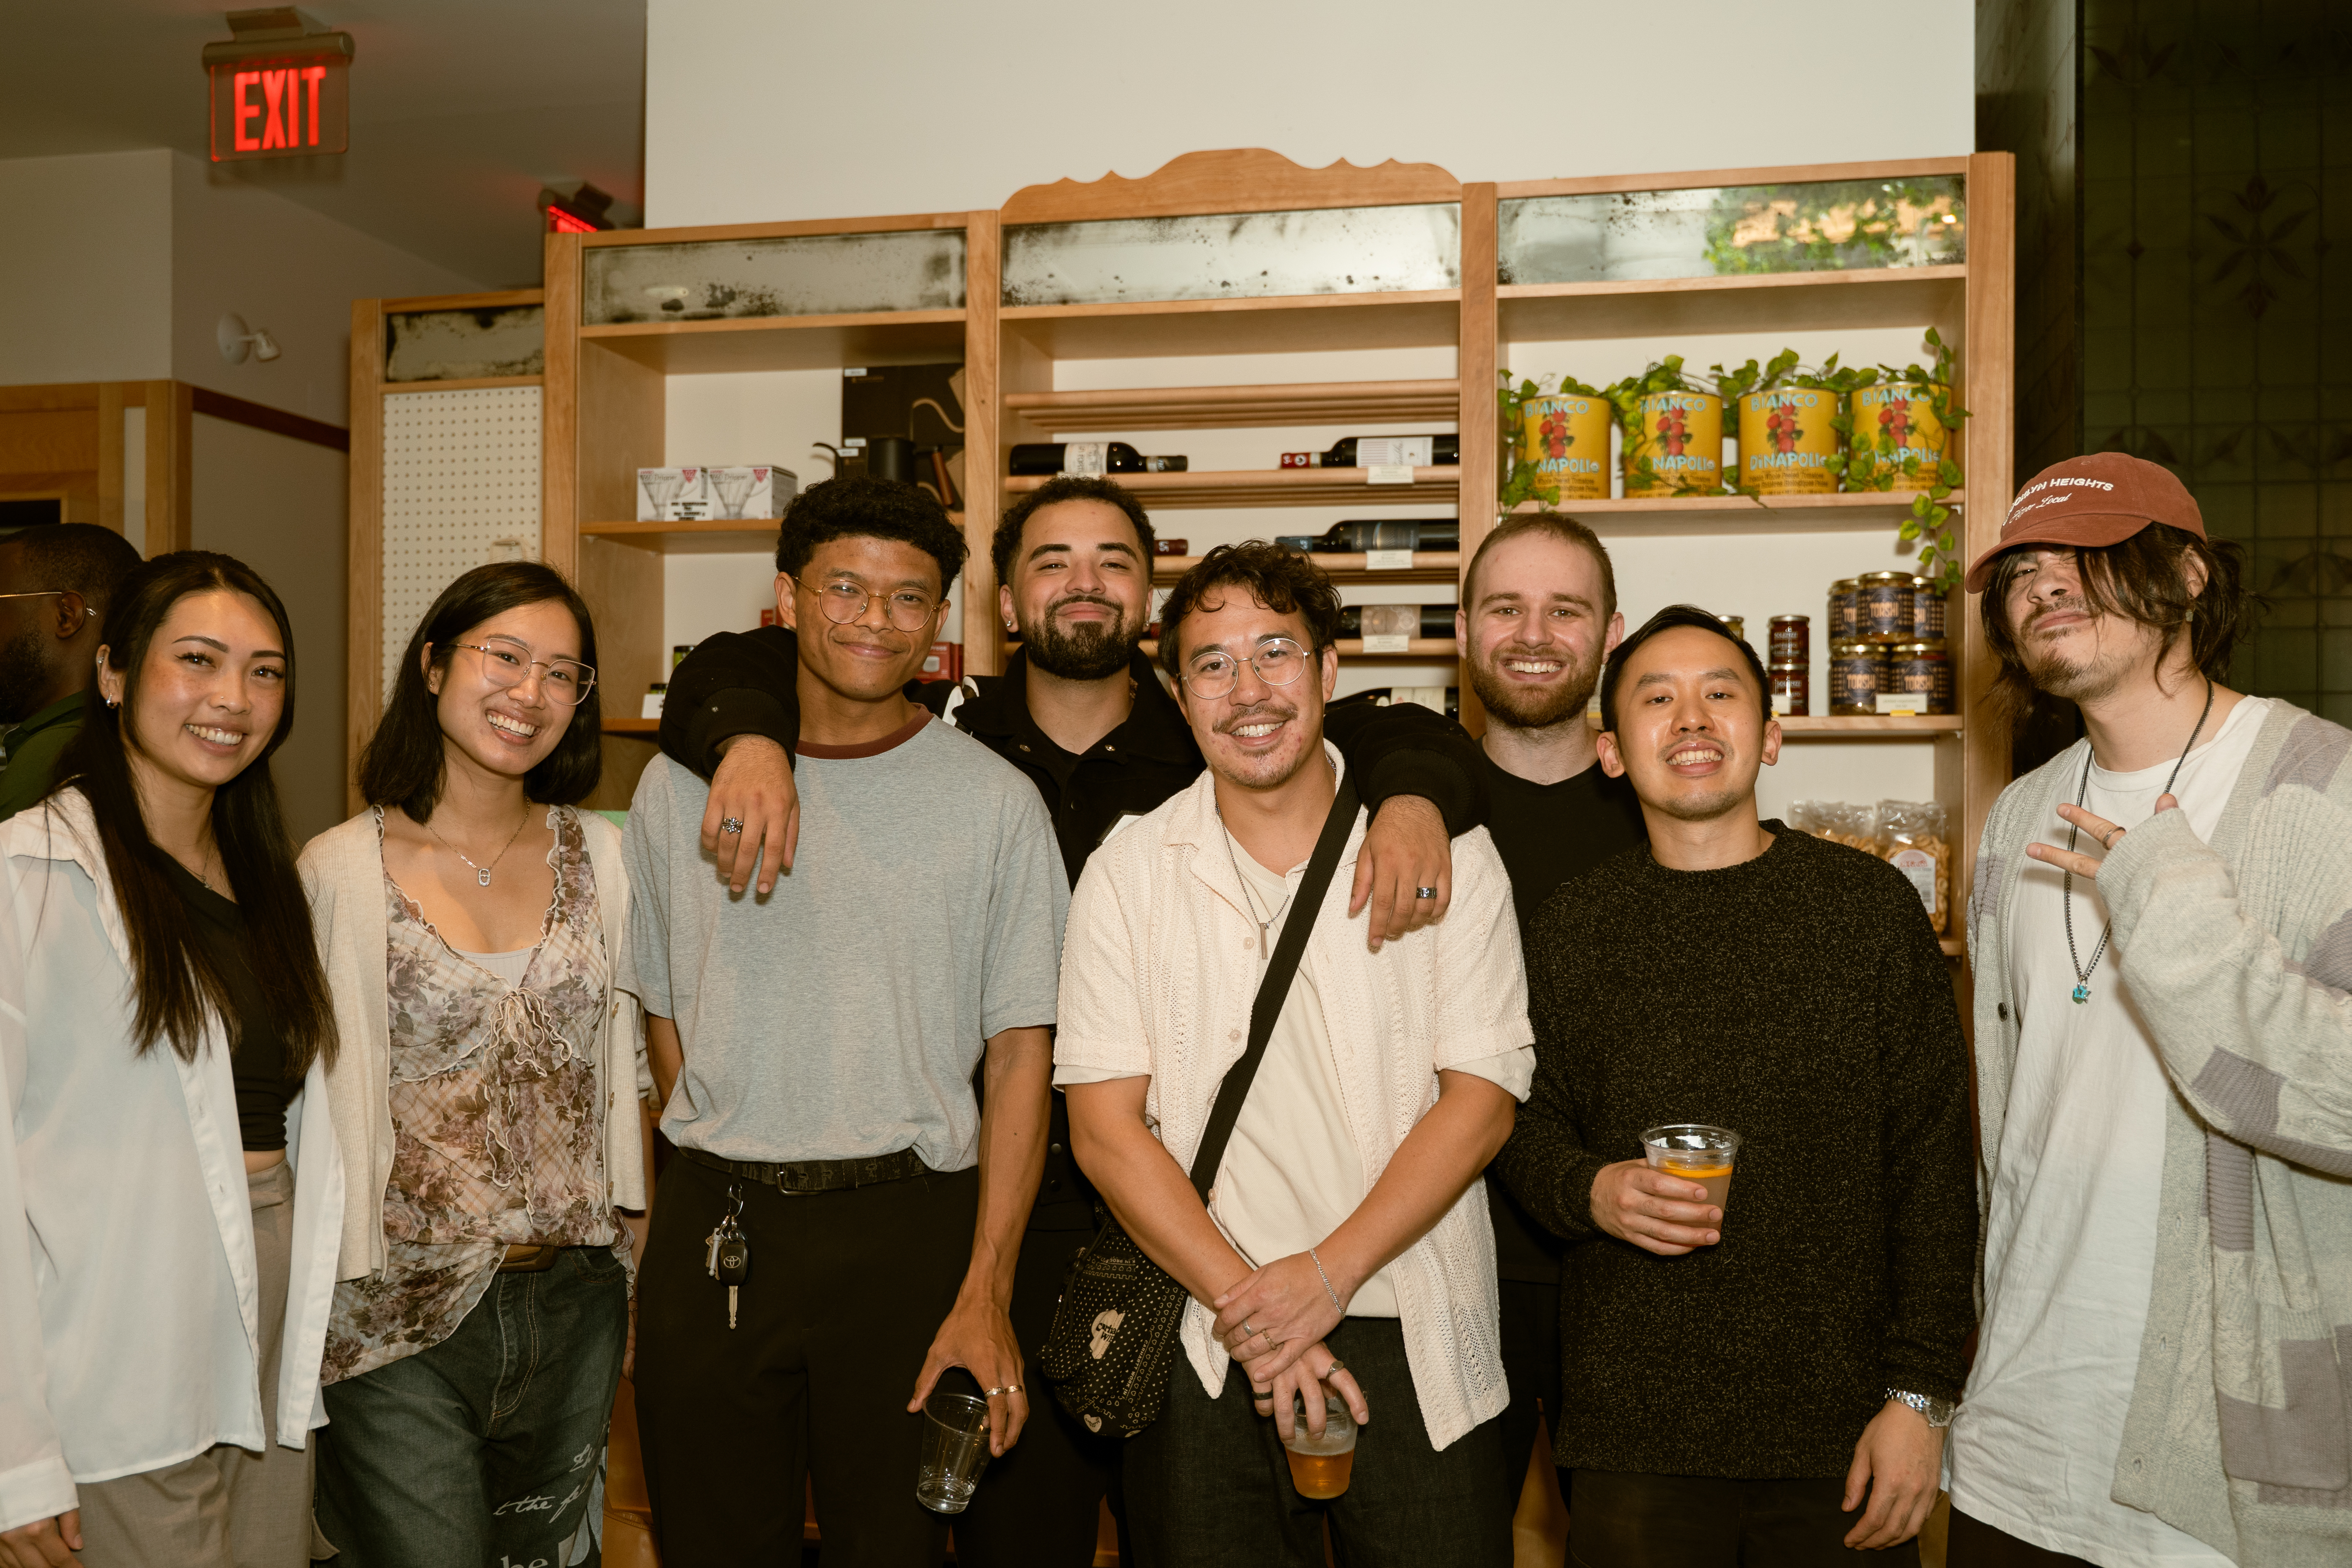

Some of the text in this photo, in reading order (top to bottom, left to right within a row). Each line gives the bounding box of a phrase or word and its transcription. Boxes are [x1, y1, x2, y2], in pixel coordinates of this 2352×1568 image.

[234, 66, 326, 152] EXIT
[1525, 400, 1589, 418] BIANCO
[1639, 397, 1706, 414] BIANCO
[1751, 394, 1817, 411] BIANCO
[1527, 458, 1590, 473] NAPOLI
[1651, 455, 1708, 471] NAPOLI
[2049, 478, 2114, 491] HEIGHTS
[2036, 493, 2072, 509] Local
[1870, 601, 1900, 618] TORSHI
[1846, 673, 1876, 690] TORSHI
[1904, 675, 1935, 690] TORSHI
[1134, 1340, 1148, 1370] CARHARTT
[1126, 1371, 1135, 1387] WORK
